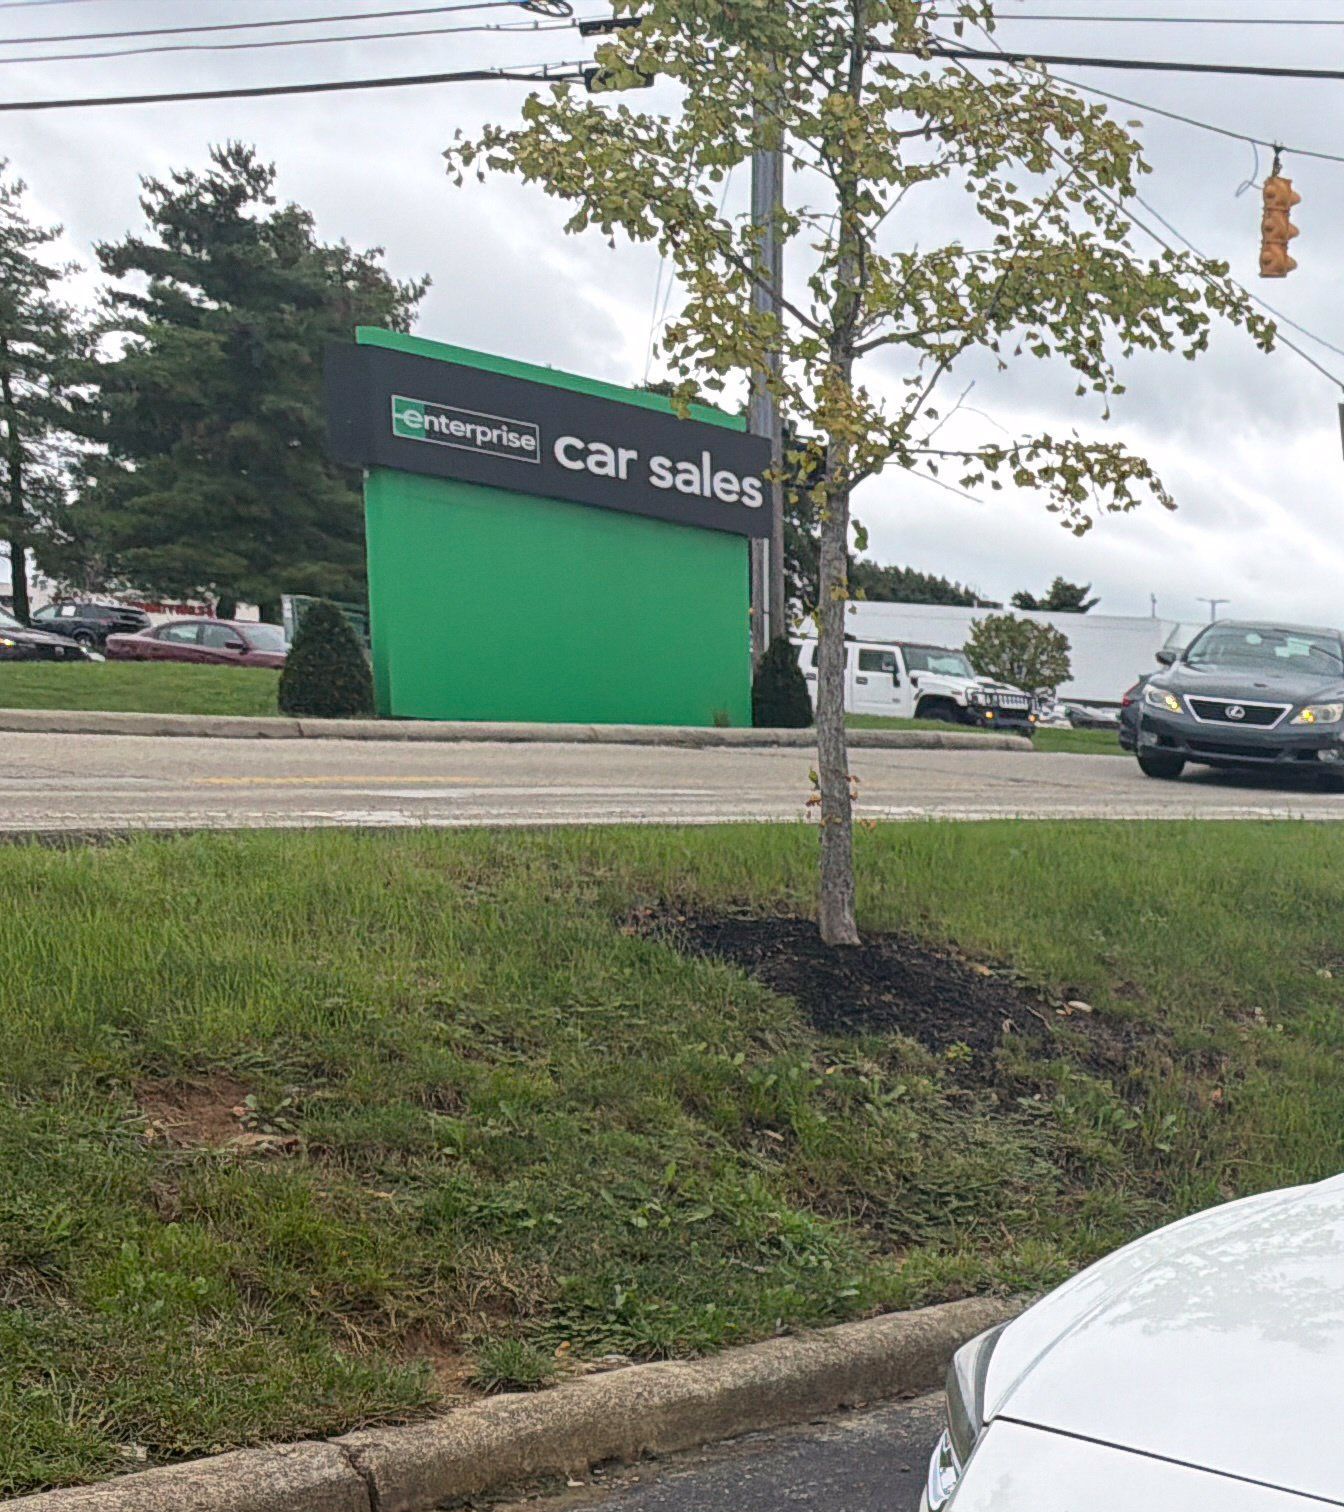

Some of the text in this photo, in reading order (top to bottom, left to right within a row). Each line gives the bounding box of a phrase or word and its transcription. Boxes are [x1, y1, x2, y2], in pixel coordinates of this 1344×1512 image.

[402, 407, 763, 508] enterprise car sales
